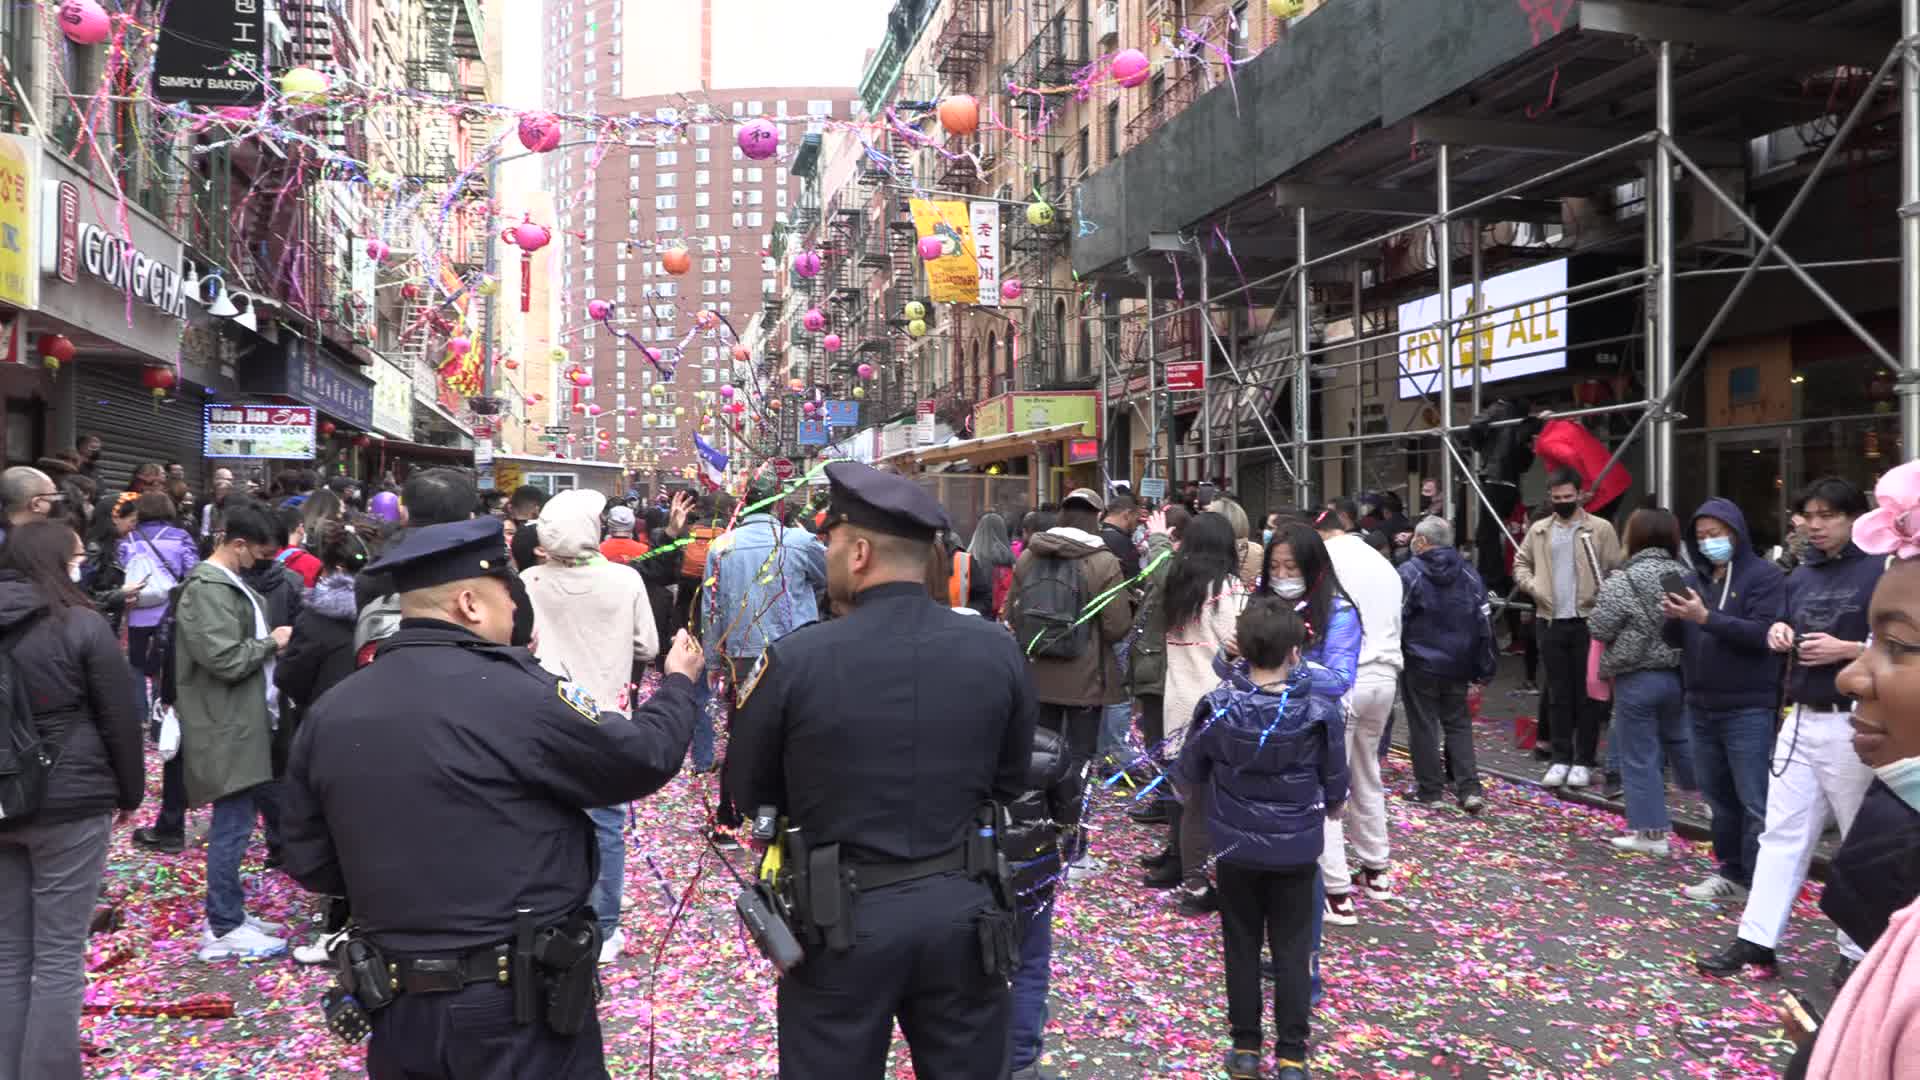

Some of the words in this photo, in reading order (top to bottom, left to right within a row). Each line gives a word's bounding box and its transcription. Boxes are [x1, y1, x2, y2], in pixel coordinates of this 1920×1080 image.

[159, 76, 204, 88] SIMPLY
[207, 79, 257, 91] BAKERY
[83, 224, 146, 298] GONG
[150, 262, 188, 319] CHA
[1506, 299, 1560, 349] ALL
